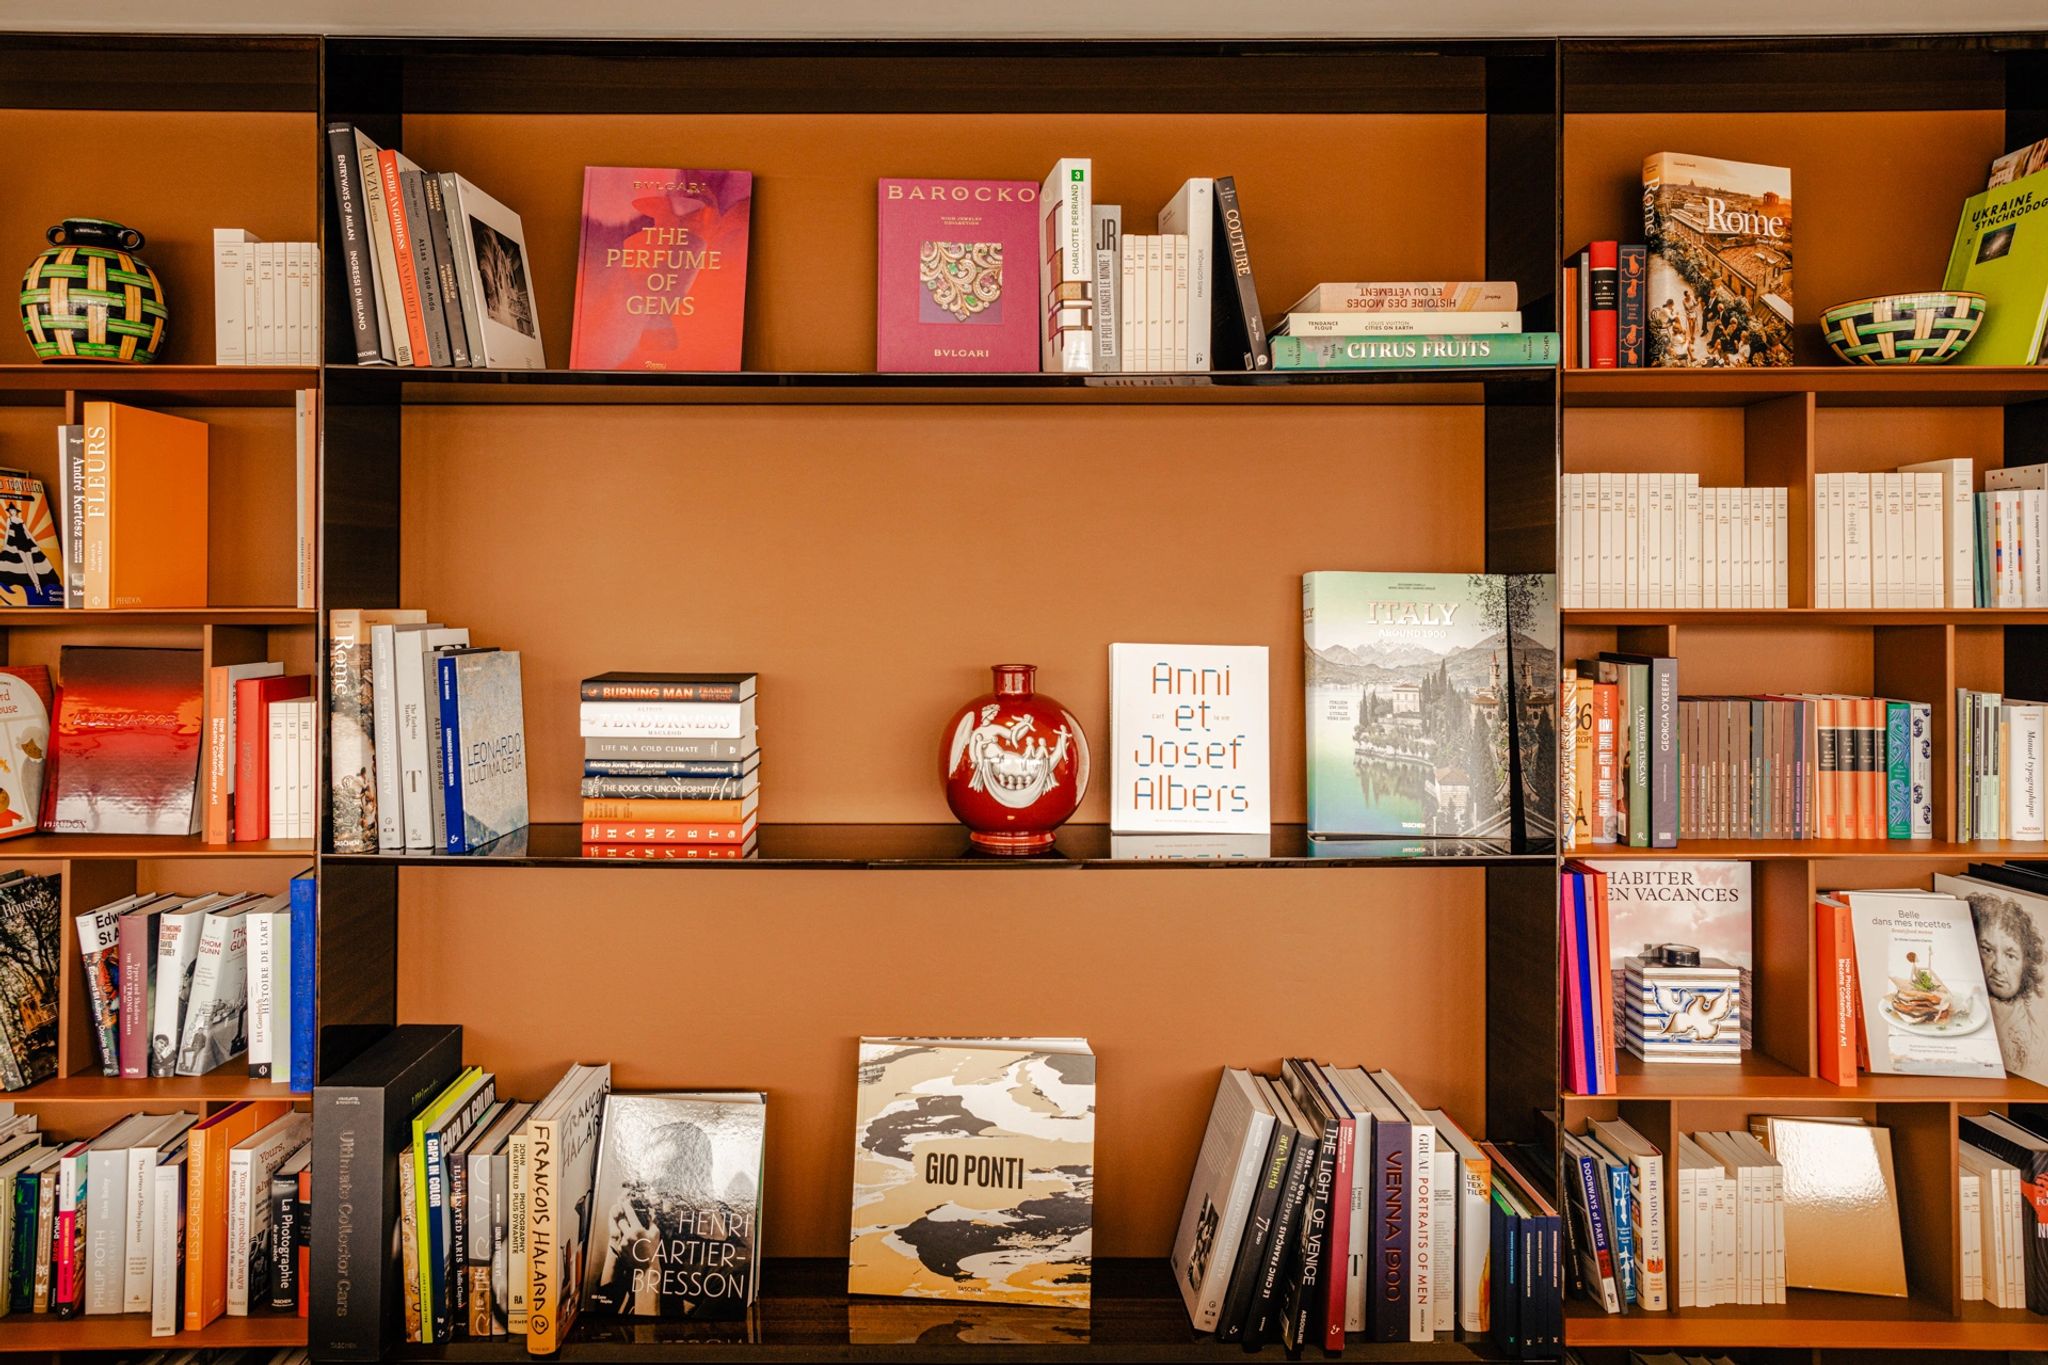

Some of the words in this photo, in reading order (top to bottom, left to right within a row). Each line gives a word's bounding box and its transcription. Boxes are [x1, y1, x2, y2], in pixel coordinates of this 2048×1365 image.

[338, 155, 350, 200] ENTRYWAYS
[363, 153, 380, 200] BAZAAR
[1074, 171, 1081, 180] 3
[344, 202, 352, 215] OF
[888, 186, 1035, 202] BAROCKO
[1644, 177, 1660, 237] Rome
[1972, 192, 2033, 222] UKRAINE
[346, 216, 355, 240] MILAN
[1706, 196, 1784, 238] Rome
[642, 228, 689, 246] THE
[1096, 219, 1117, 251] JR
[1226, 209, 1250, 277] COUTURE
[606, 249, 721, 270] PERFUME
[1072, 227, 1080, 274] CHARLOTTE
[647, 273, 678, 291] OF
[1360, 288, 1411, 298] VÊTEMENT
[1414, 288, 1428, 296] DU
[1432, 288, 1442, 296] ET
[427, 292, 435, 311] Ando
[626, 296, 695, 316] GEMS
[1347, 299, 1384, 308] MODES
[1388, 299, 1407, 308] DES
[1412, 299, 1456, 308] HISTOIRE
[934, 349, 989, 357] BVLGARI
[1347, 342, 1416, 359] CITRUS
[1422, 340, 1490, 358] FRUITS
[73, 457, 85, 490] André
[88, 426, 106, 518] FLEURS
[74, 495, 85, 540] Kertész
[1367, 602, 1459, 626] ITALY
[1378, 630, 1421, 639] AROUND
[1423, 630, 1447, 639] 1900
[334, 634, 354, 695] Rome
[1153, 662, 1230, 696] Anni
[603, 687, 659, 698] BURNING
[663, 688, 693, 698] MAN
[1662, 673, 1670, 711] O'KEEFFE
[601, 712, 730, 729] TENDERNESS
[1176, 700, 1211, 732] et
[1662, 713, 1670, 750] GEORGIA
[2027, 730, 2036, 760] Manuel
[216, 734, 225, 776] Photography
[468, 733, 521, 766] LEONARDO
[1135, 734, 1246, 769] Josef
[406, 770, 422, 792] T
[603, 784, 617, 792] THE
[618, 784, 640, 792] BOOK
[654, 785, 720, 793] UNCONFORMITIES
[1134, 775, 1249, 812] Albers
[2026, 761, 2036, 817] typographique
[1607, 872, 1694, 885] HABITER
[2, 899, 42, 916] Houses
[1608, 888, 1629, 900] EN
[1634, 888, 1739, 902] VACANCES
[1872, 917, 1892, 926] dans
[1915, 921, 1952, 929] recettes
[1898, 910, 1919, 919] Belle
[99, 932, 112, 945] St
[160, 940, 173, 948] DAVID
[201, 938, 222, 948] THOM
[260, 920, 268, 946] L'ART
[160, 948, 175, 956] STOREY
[200, 946, 220, 956] GUNN
[261, 950, 268, 966] DE
[260, 966, 269, 1015] HISTOIRE
[441, 1125, 461, 1156] CAPA
[462, 1114, 471, 1129] IN
[472, 1083, 494, 1118] COLOR
[561, 1078, 610, 1145] FRANÇOIS
[192, 1140, 200, 1167] LUXE
[260, 1143, 285, 1163] Yours,
[428, 1140, 440, 1163] CAPA
[1275, 1134, 1290, 1155] arte
[1323, 1127, 1339, 1155] THE
[1419, 1133, 1429, 1175] GRUAU
[339, 1131, 353, 1199] Ultimate
[429, 1165, 440, 1175] IN
[533, 1126, 550, 1225] FRANÇOIS
[925, 1153, 958, 1185] GIO
[964, 1156, 1024, 1190] PONTI
[1267, 1156, 1287, 1189] Veneta
[1292, 1147, 1307, 1179] FEMMES
[1295, 1184, 1305, 1204] 1900
[1304, 1150, 1314, 1168] 1950
[191, 1171, 200, 1187] DU
[239, 1171, 247, 1198] Yours,
[429, 1177, 440, 1207] COLOR
[1290, 1181, 1299, 1190] DE
[1316, 1160, 1333, 1203] LIGHT
[282, 1199, 293, 1211] La
[454, 1165, 463, 1233] ILLUMINATED
[1282, 1194, 1295, 1224] IMAGES
[1385, 1150, 1403, 1240] VIENNA
[1583, 1162, 1597, 1210] DOORWAYS
[1594, 1223, 1605, 1246] PARIS
[1650, 1180, 1658, 1226] READING
[191, 1190, 199, 1238] SECRETS
[678, 1209, 751, 1237] HENRI
[1311, 1209, 1326, 1229] OF
[1417, 1177, 1428, 1249] PORTRAITS
[95, 1230, 105, 1267] ROTH
[190, 1241, 199, 1260] LES
[238, 1218, 247, 1255] probably
[278, 1214, 293, 1288] Photographie
[337, 1204, 352, 1276] Collector
[1271, 1226, 1288, 1266] FRANÇAIS
[1651, 1230, 1659, 1251] LIST
[632, 1239, 746, 1268] CARTIER-
[1303, 1234, 1322, 1286] VENICE
[1418, 1252, 1428, 1270] OF
[236, 1259, 246, 1290] always
[533, 1231, 549, 1311] HALARD
[632, 1269, 744, 1299] BRESSON
[1265, 1268, 1276, 1288] CHIC
[1385, 1249, 1401, 1301] 1900
[94, 1270, 105, 1307] PHILIP
[336, 1280, 350, 1317] Cars
[1262, 1288, 1271, 1298] LE
[1417, 1274, 1428, 1305] MEN
[1297, 1310, 1307, 1344] ASSOULINE
